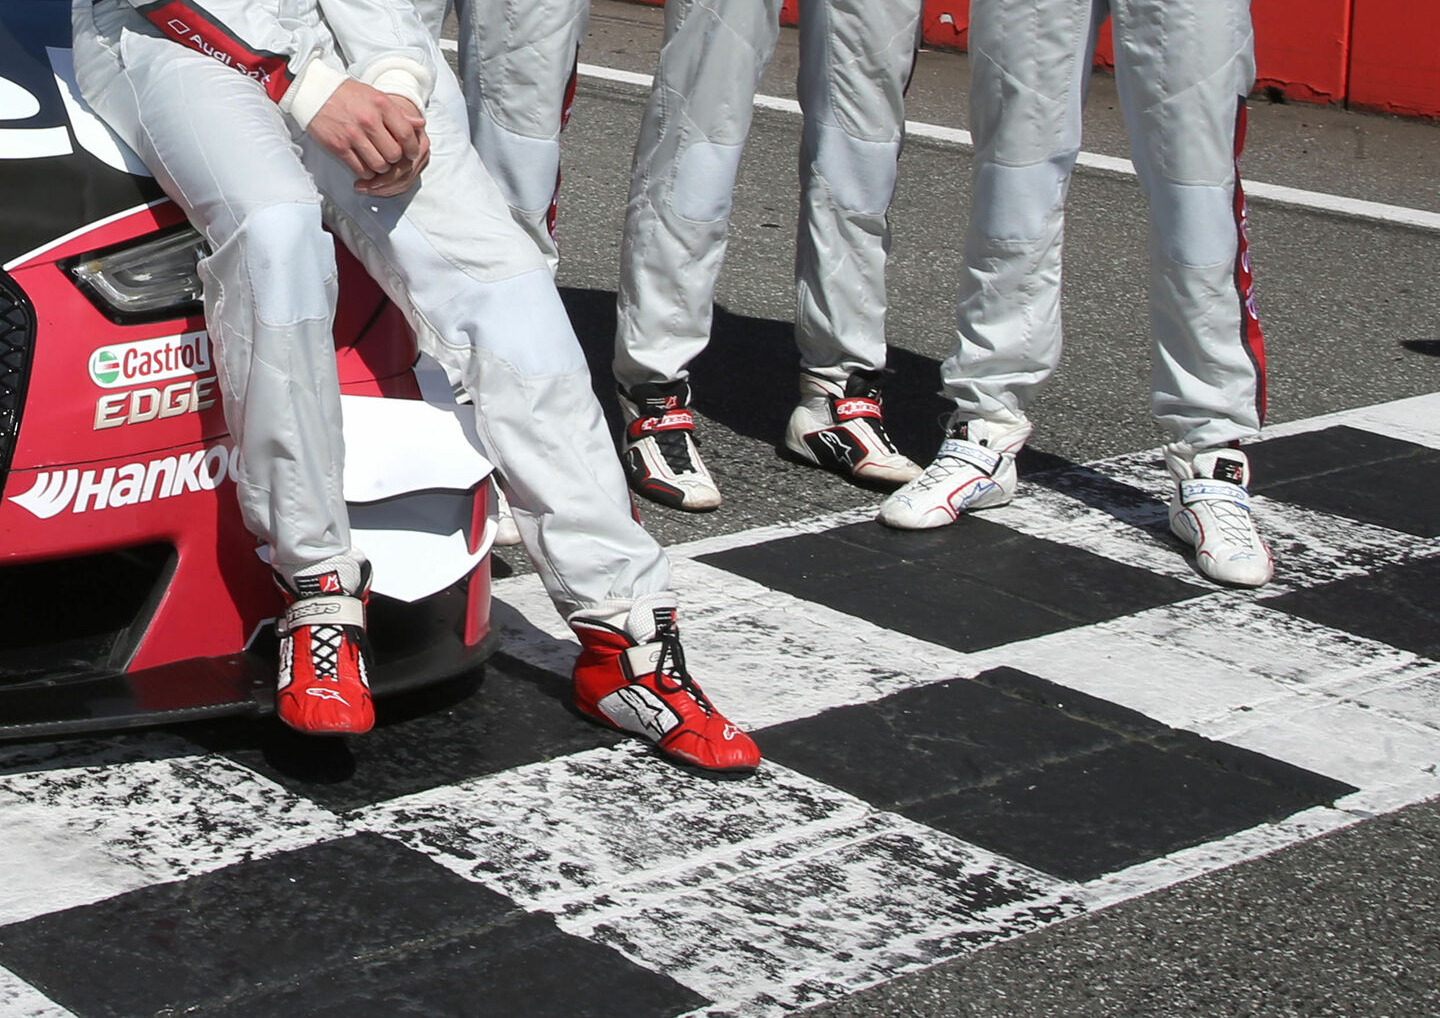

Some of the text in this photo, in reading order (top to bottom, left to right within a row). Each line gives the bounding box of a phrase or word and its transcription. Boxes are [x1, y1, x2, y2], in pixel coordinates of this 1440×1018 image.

[189, 34, 232, 66] Audi
[123, 337, 204, 379] Castrol
[93, 375, 218, 431] EDGE
